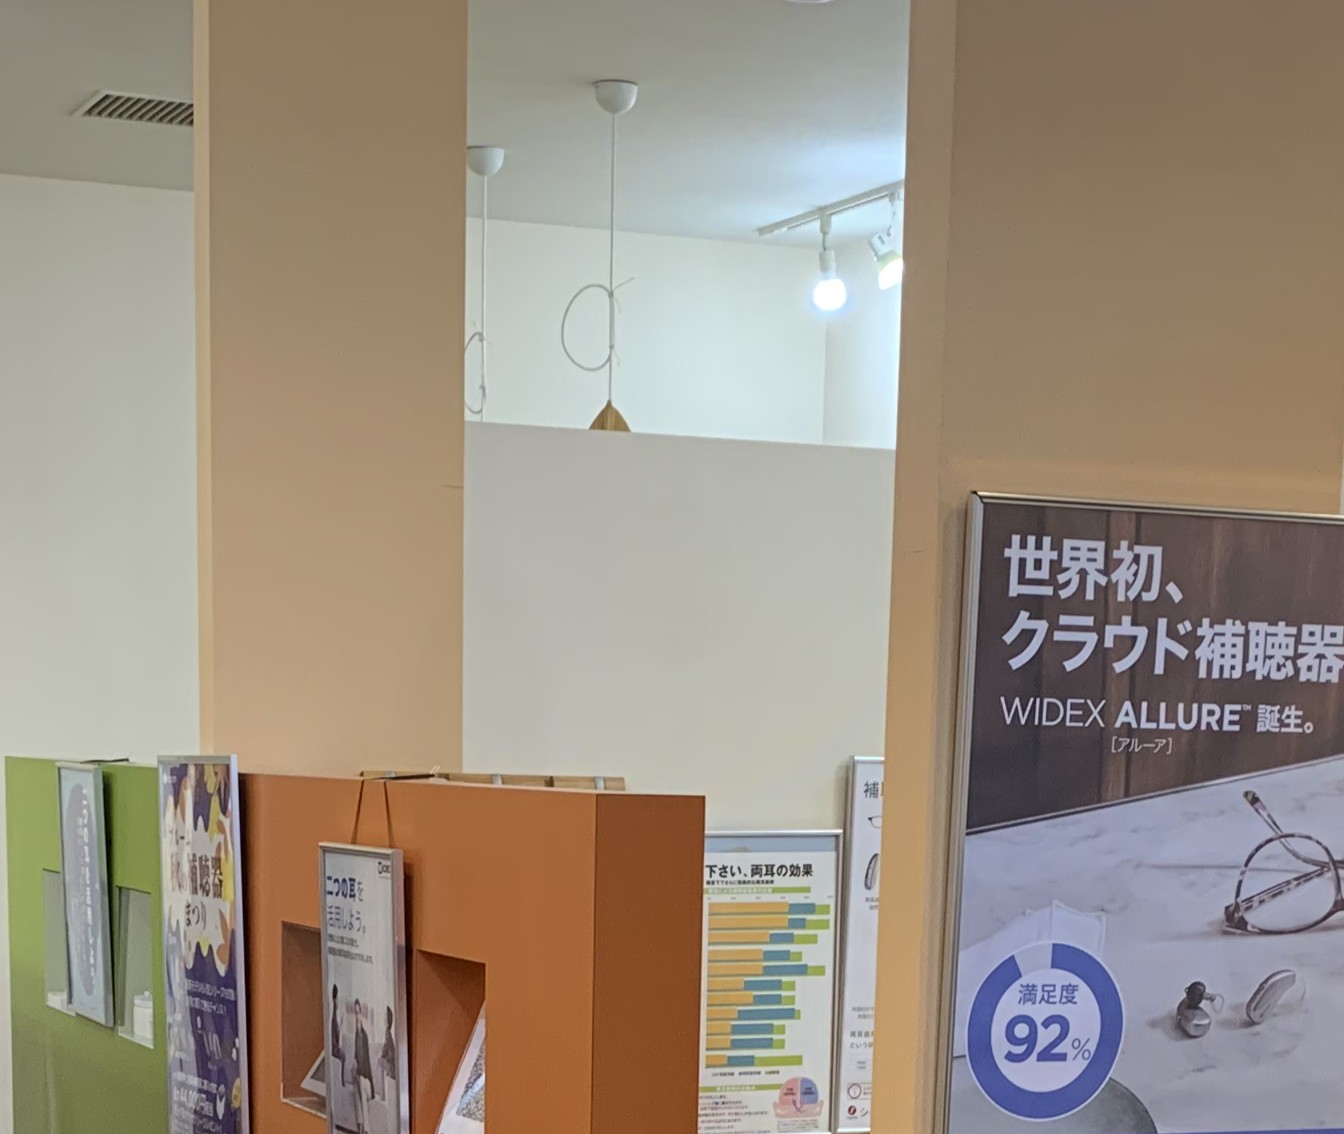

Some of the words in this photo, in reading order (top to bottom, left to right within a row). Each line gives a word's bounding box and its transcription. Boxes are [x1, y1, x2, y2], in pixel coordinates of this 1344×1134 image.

[1003, 534, 1184, 603] 世界初、
[1000, 696, 1105, 728] WIDEX
[1256, 704, 1315, 735] 誕生。
[863, 781, 883, 799] 補
[1018, 983, 1078, 1006] 満足度
[1004, 1014, 1092, 1064] 92%
